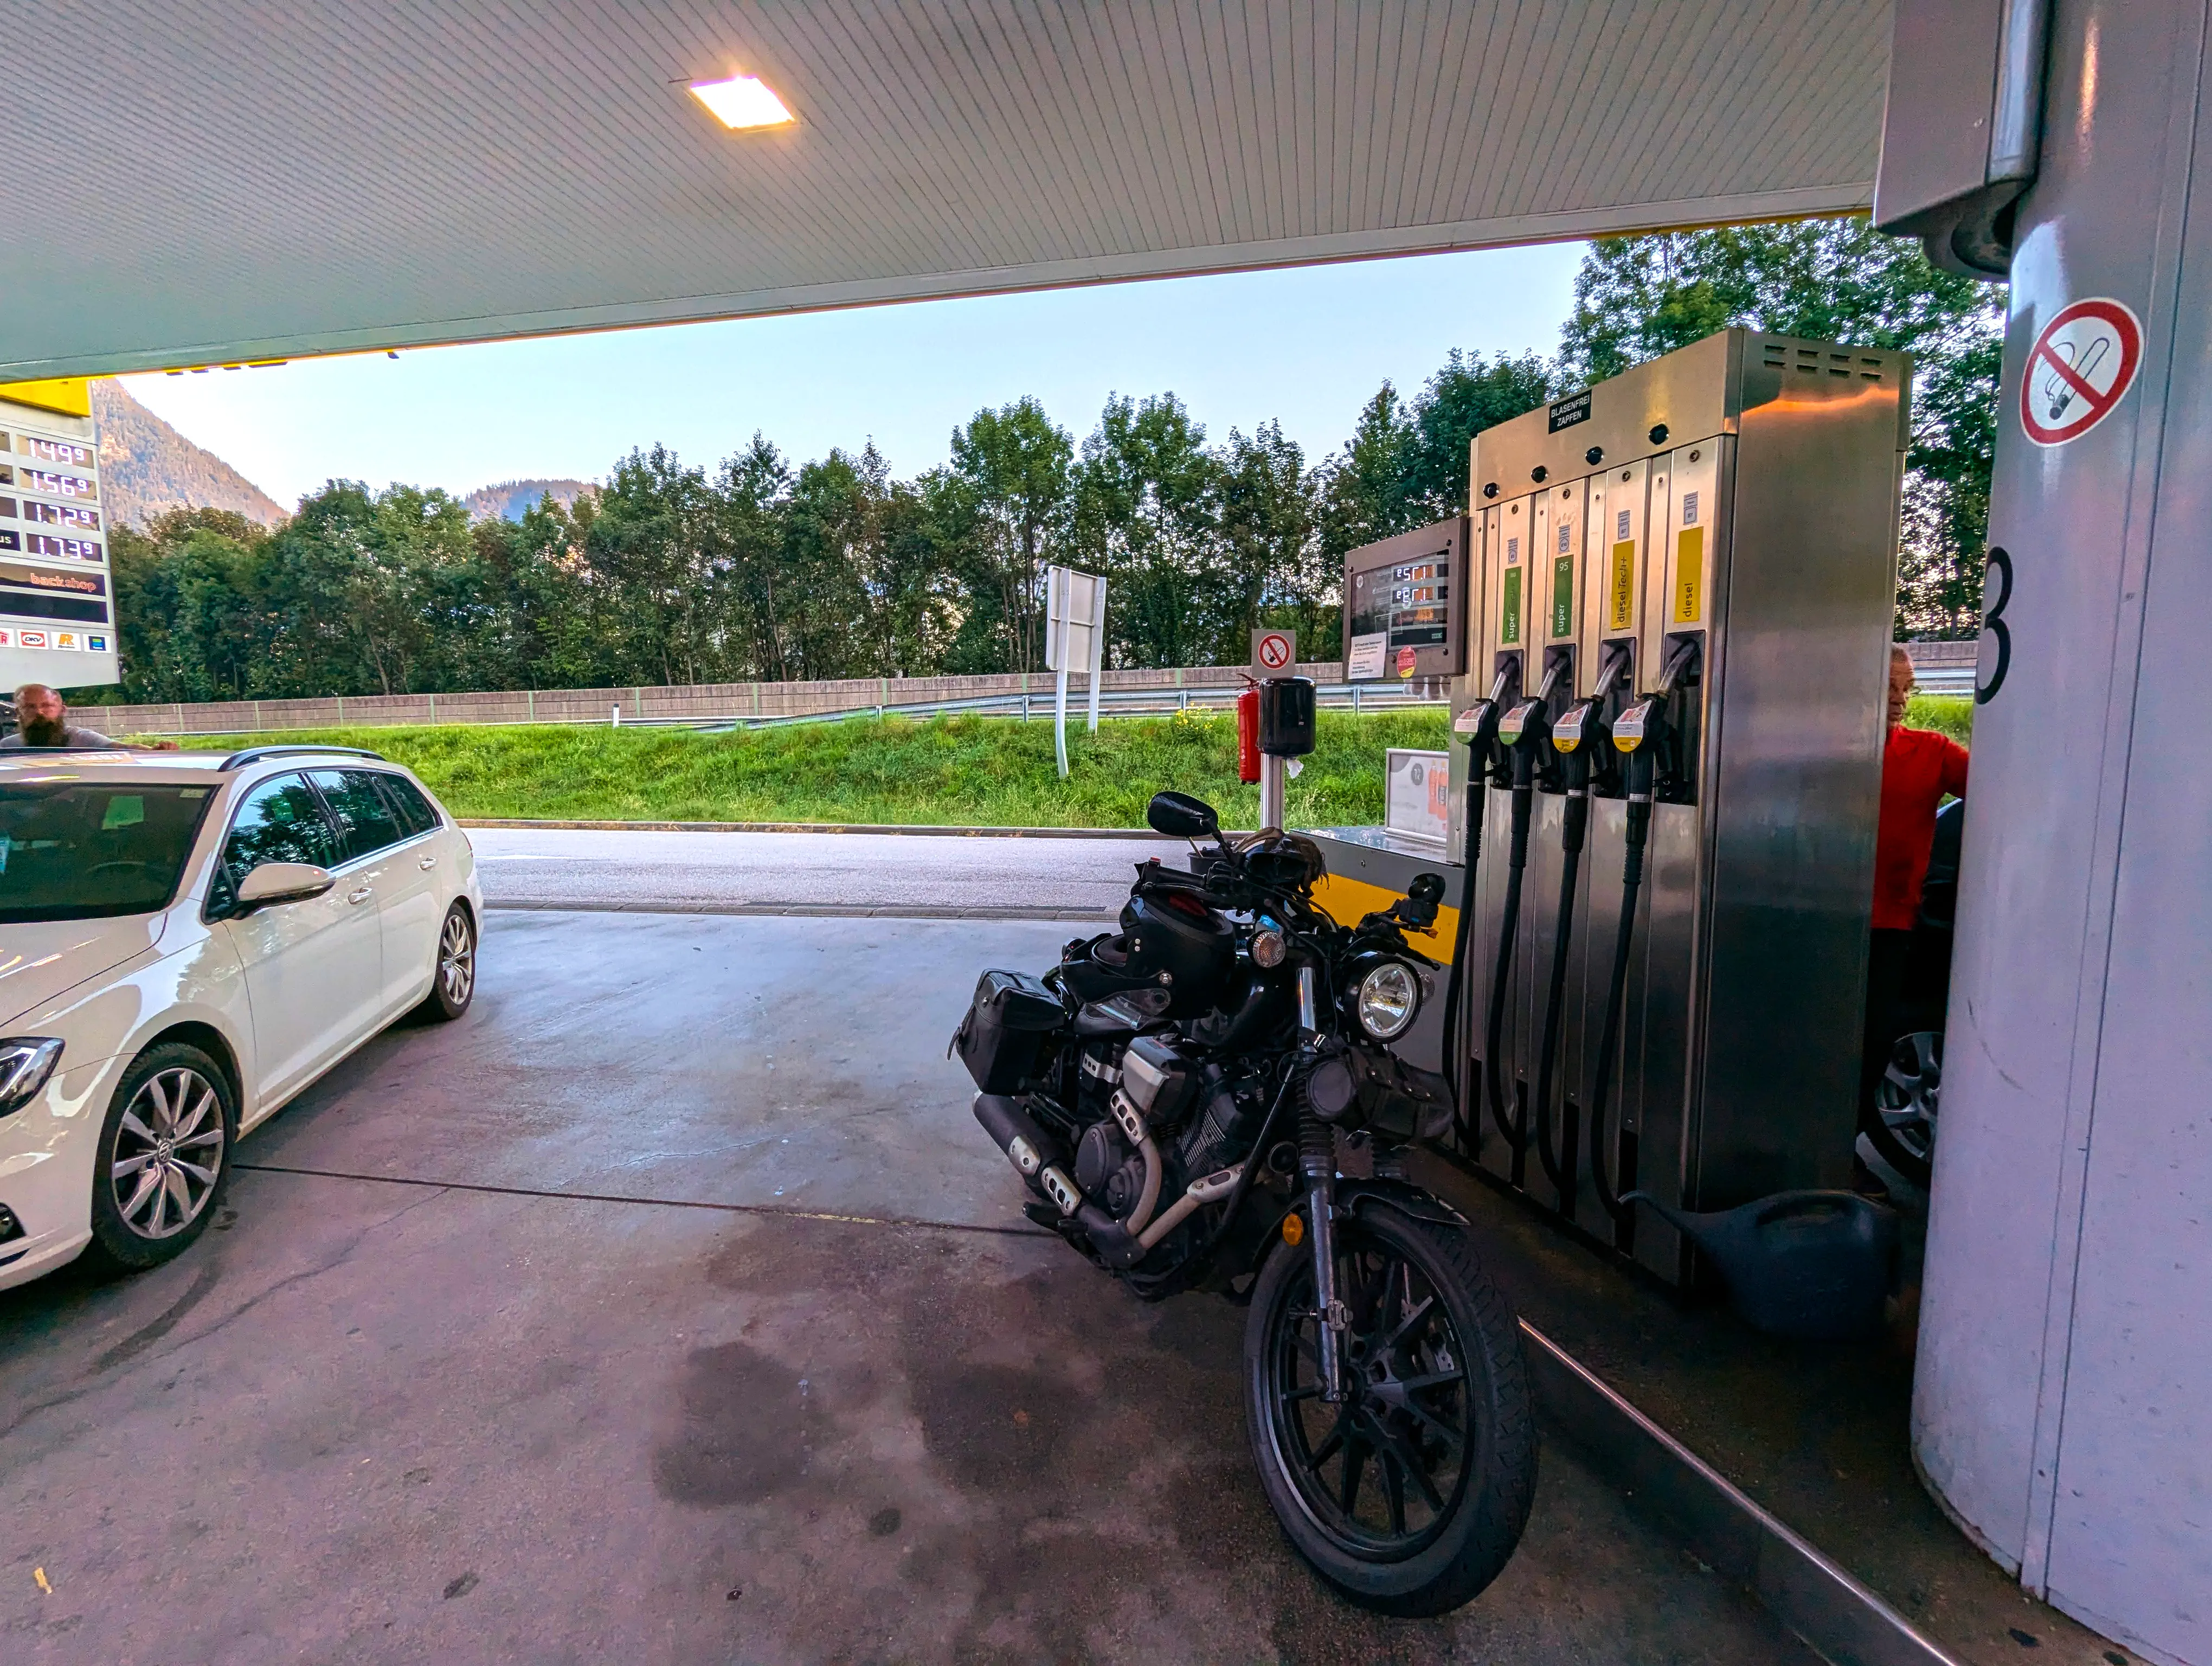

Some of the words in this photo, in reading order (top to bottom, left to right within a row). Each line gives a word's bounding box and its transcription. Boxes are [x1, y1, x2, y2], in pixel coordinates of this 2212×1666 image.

[1551, 394, 1590, 418] BLASENFREI
[1557, 409, 1582, 427] ZAPFEN
[1559, 561, 1568, 572] 95
[1618, 556, 1627, 588] Tech+
[30, 573, 97, 593] backshop
[1617, 591, 1626, 623] diesel
[1683, 582, 1693, 618] diesel
[1975, 546, 2013, 705] 3
